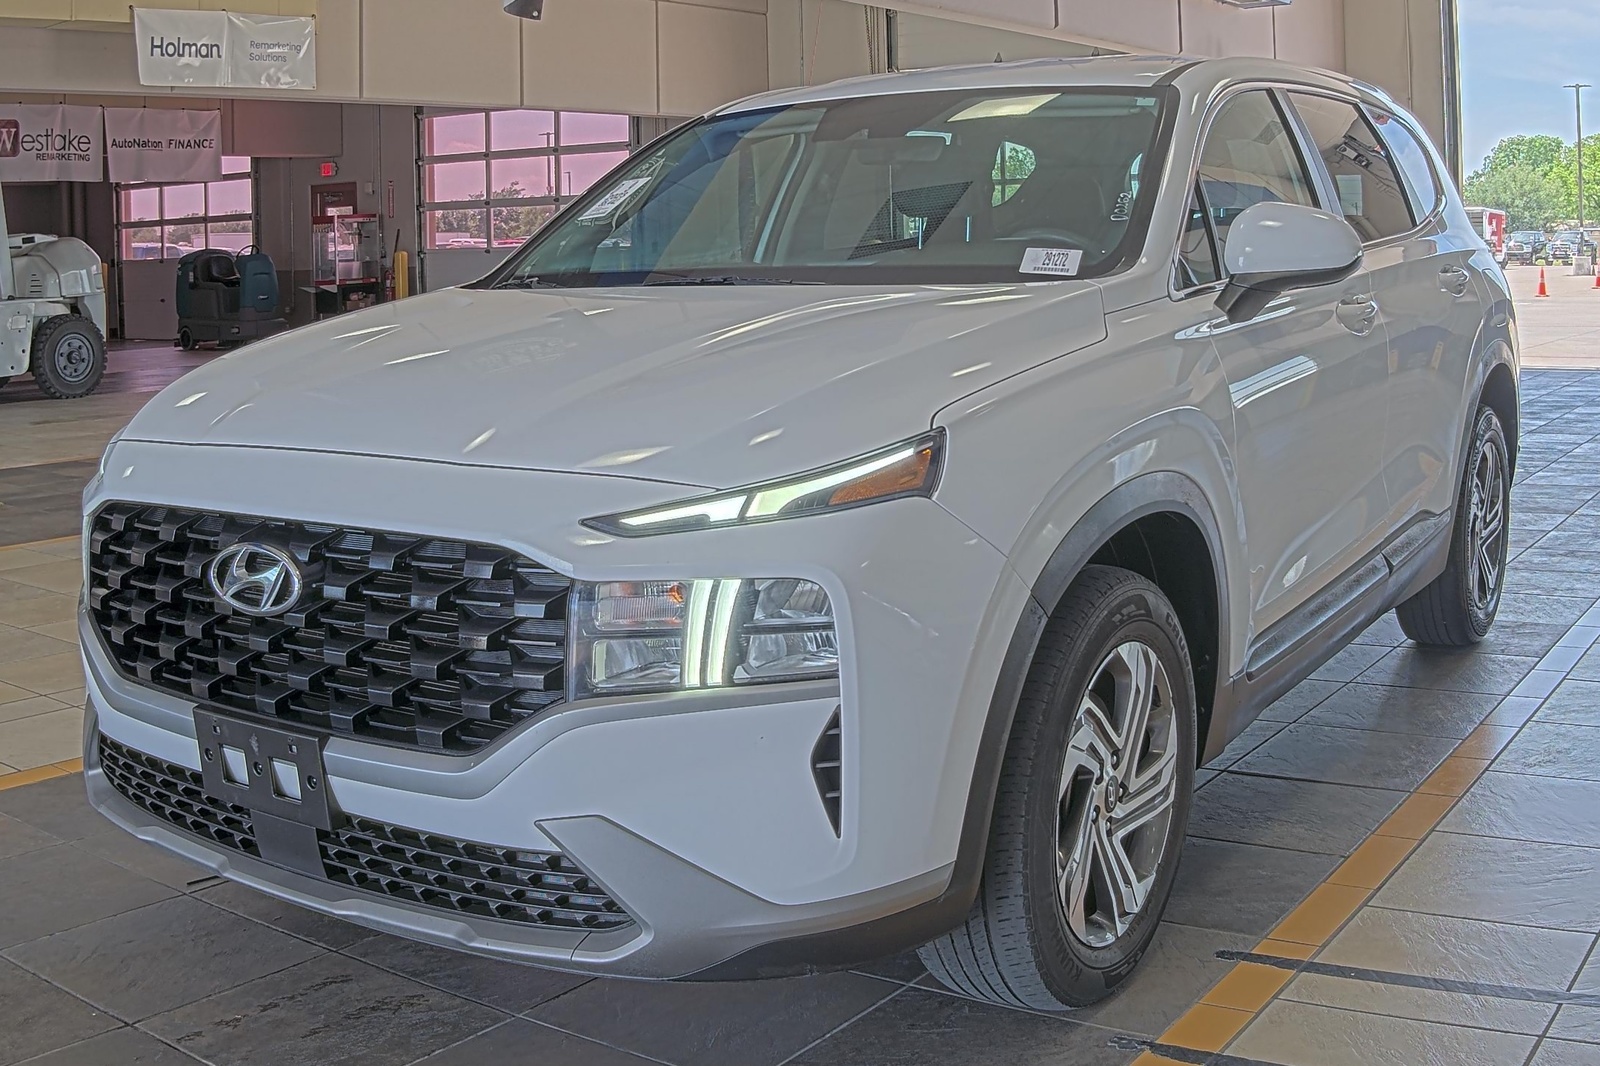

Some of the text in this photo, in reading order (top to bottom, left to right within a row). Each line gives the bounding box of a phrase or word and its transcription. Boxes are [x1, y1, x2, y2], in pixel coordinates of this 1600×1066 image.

[150, 36, 222, 59] Holman
[249, 40, 302, 54] Remarketing
[248, 52, 288, 63] Solutions
[110, 138, 214, 149] AutoNation FINANCE
[36, 152, 91, 162] REMARKETING
[1041, 252, 1069, 267] 291272
